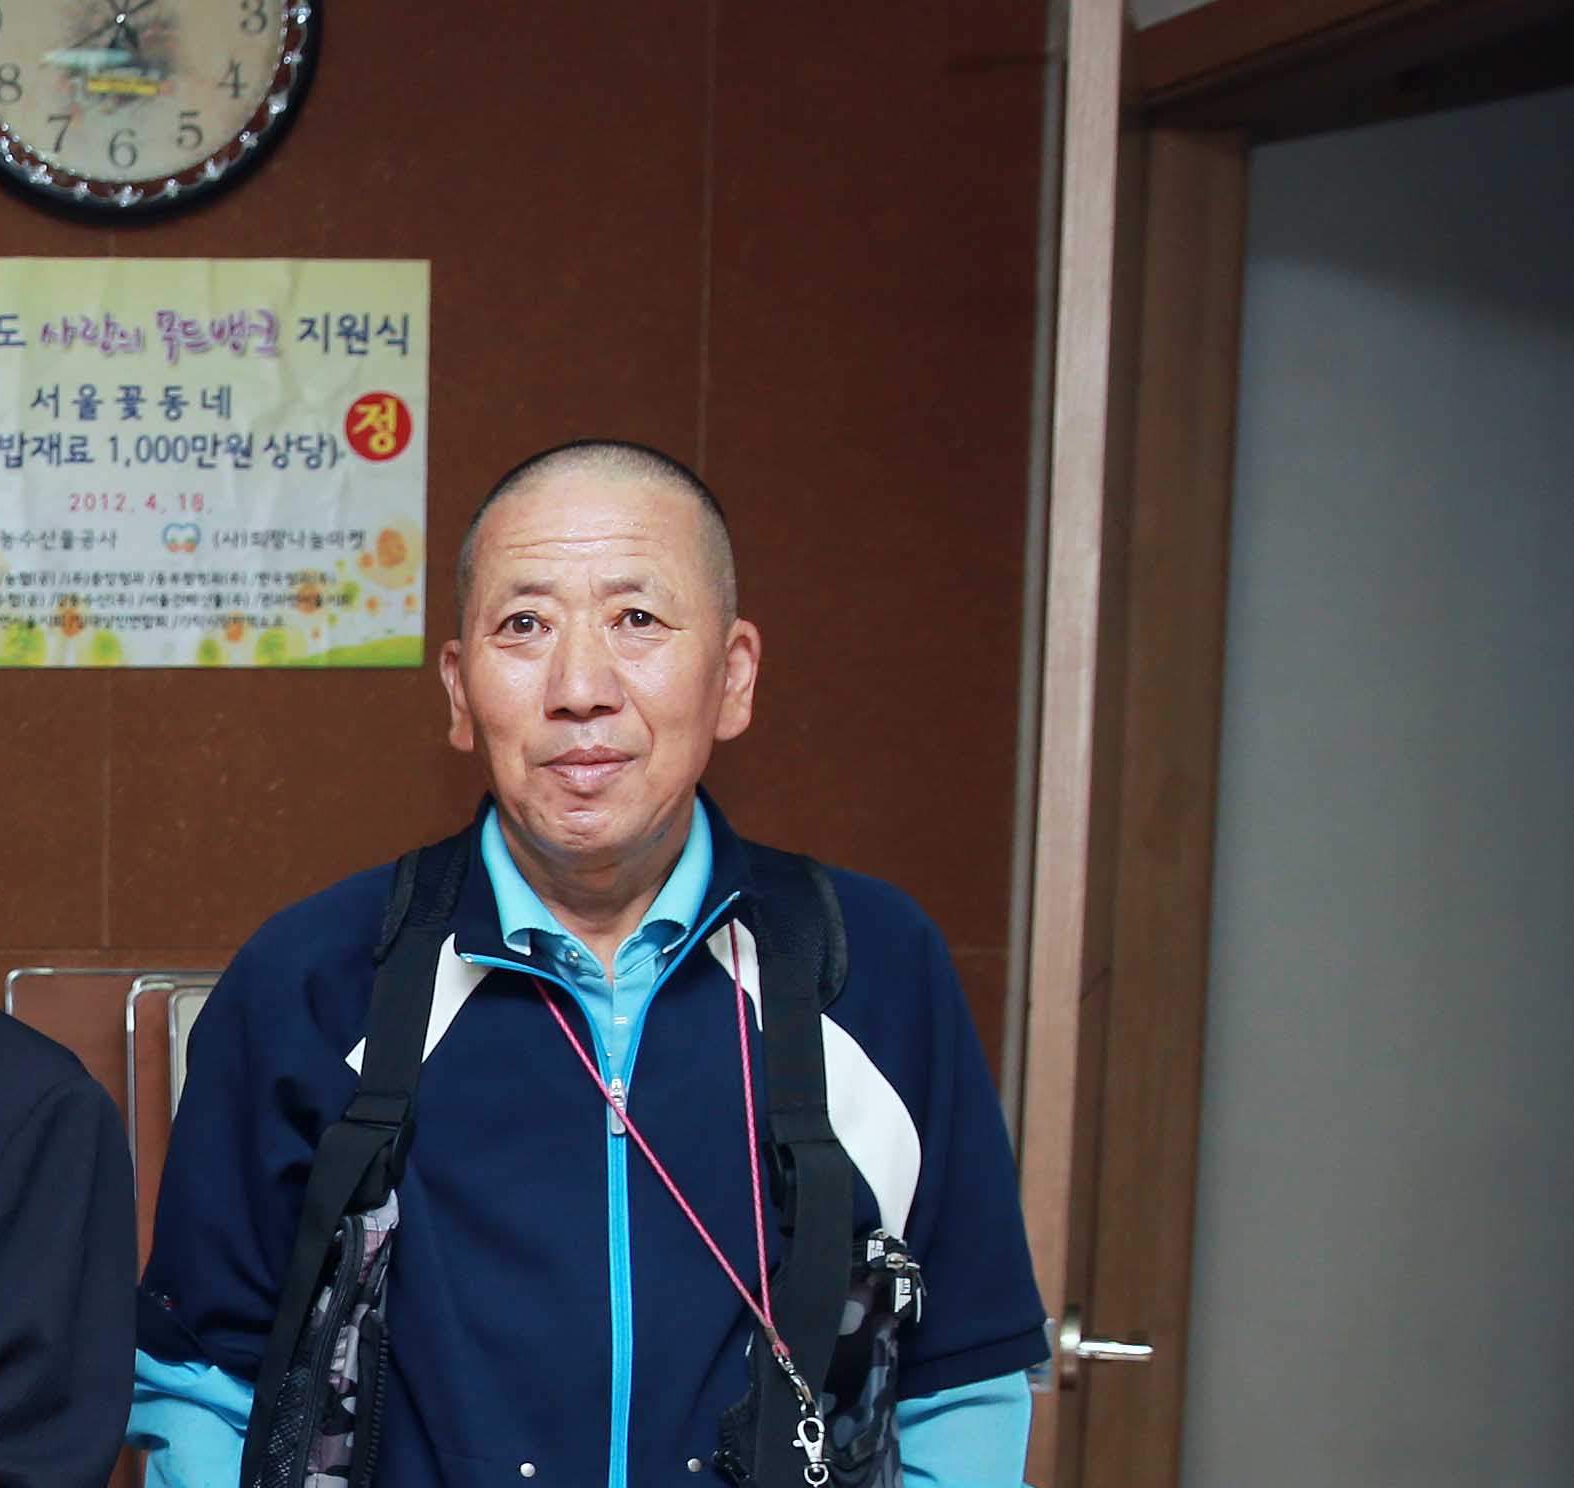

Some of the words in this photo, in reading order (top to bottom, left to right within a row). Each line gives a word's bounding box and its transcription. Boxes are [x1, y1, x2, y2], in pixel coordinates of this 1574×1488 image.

[218, 59, 247, 99] 4
[47, 114, 72, 153] 7
[108, 129, 137, 169] 6
[176, 111, 202, 150] 5
[156, 309, 278, 365] 푸드뱅크
[298, 312, 409, 356] 지원식
[109, 431, 254, 469] 1,000만원
[263, 432, 338, 469] 상당)
